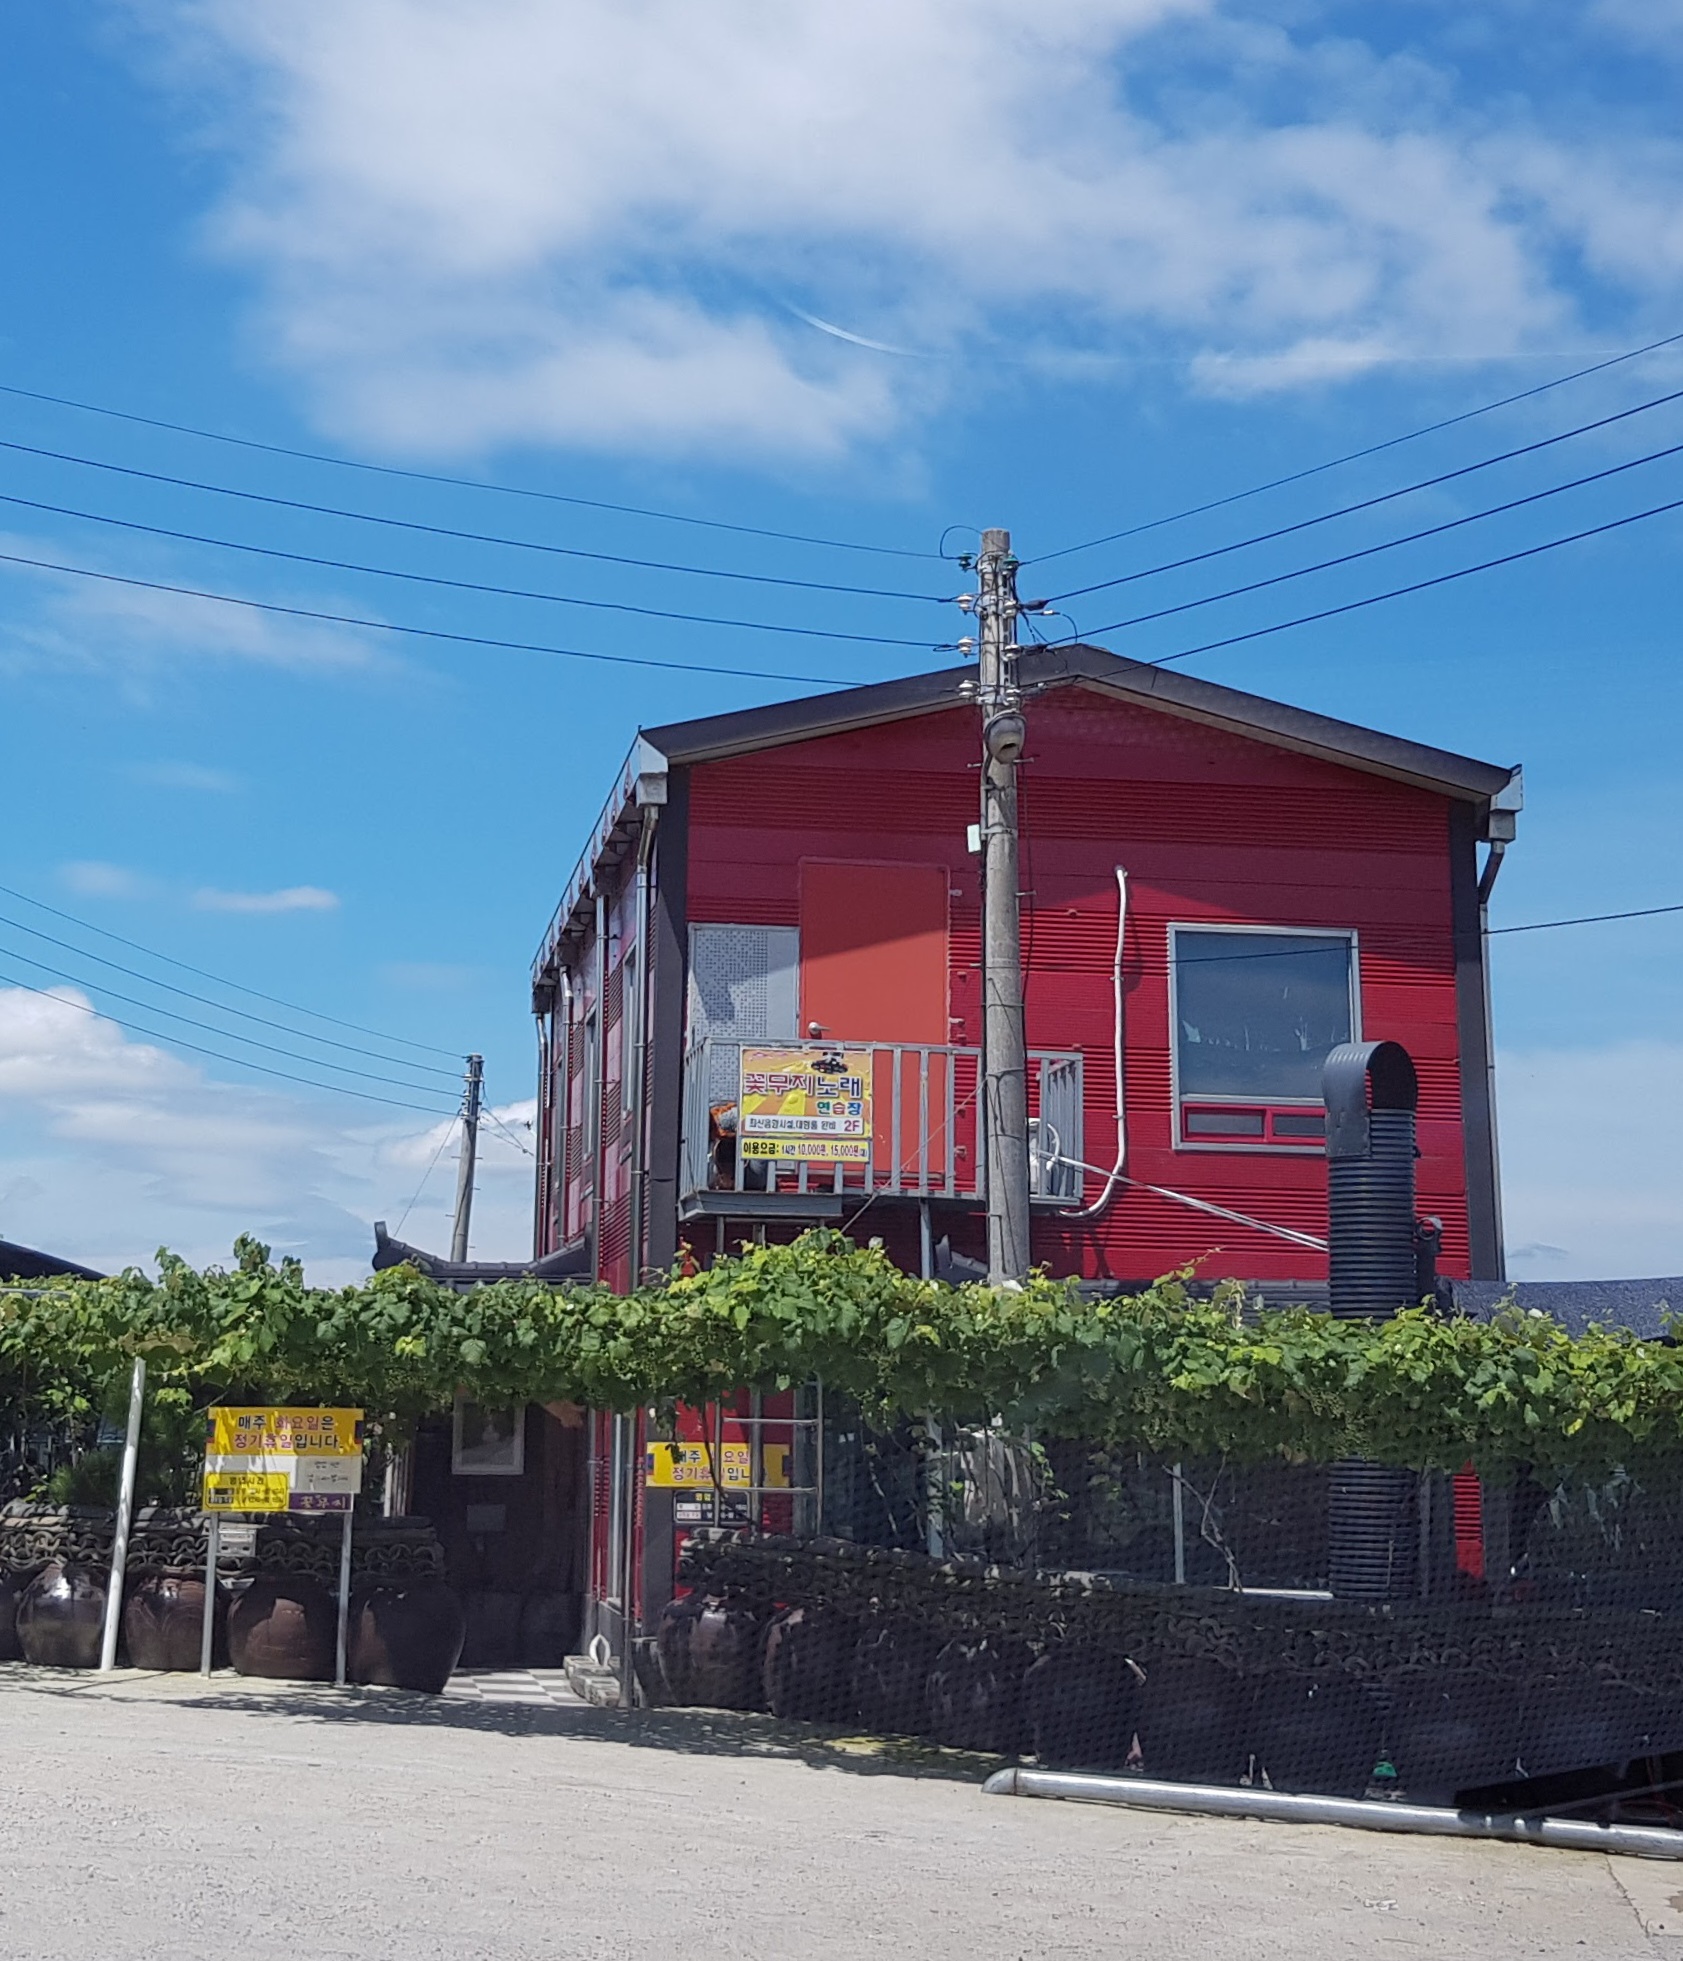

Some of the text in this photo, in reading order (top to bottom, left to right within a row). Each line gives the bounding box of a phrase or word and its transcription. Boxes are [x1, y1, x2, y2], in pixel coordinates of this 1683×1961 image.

[817, 1101, 862, 1116] 연습장
[844, 1120, 860, 1132] 2F
[744, 1142, 779, 1155] 이용요금:
[238, 1415, 334, 1431] 매주 화요일은
[234, 1434, 344, 1449] 정기휴일입니다.
